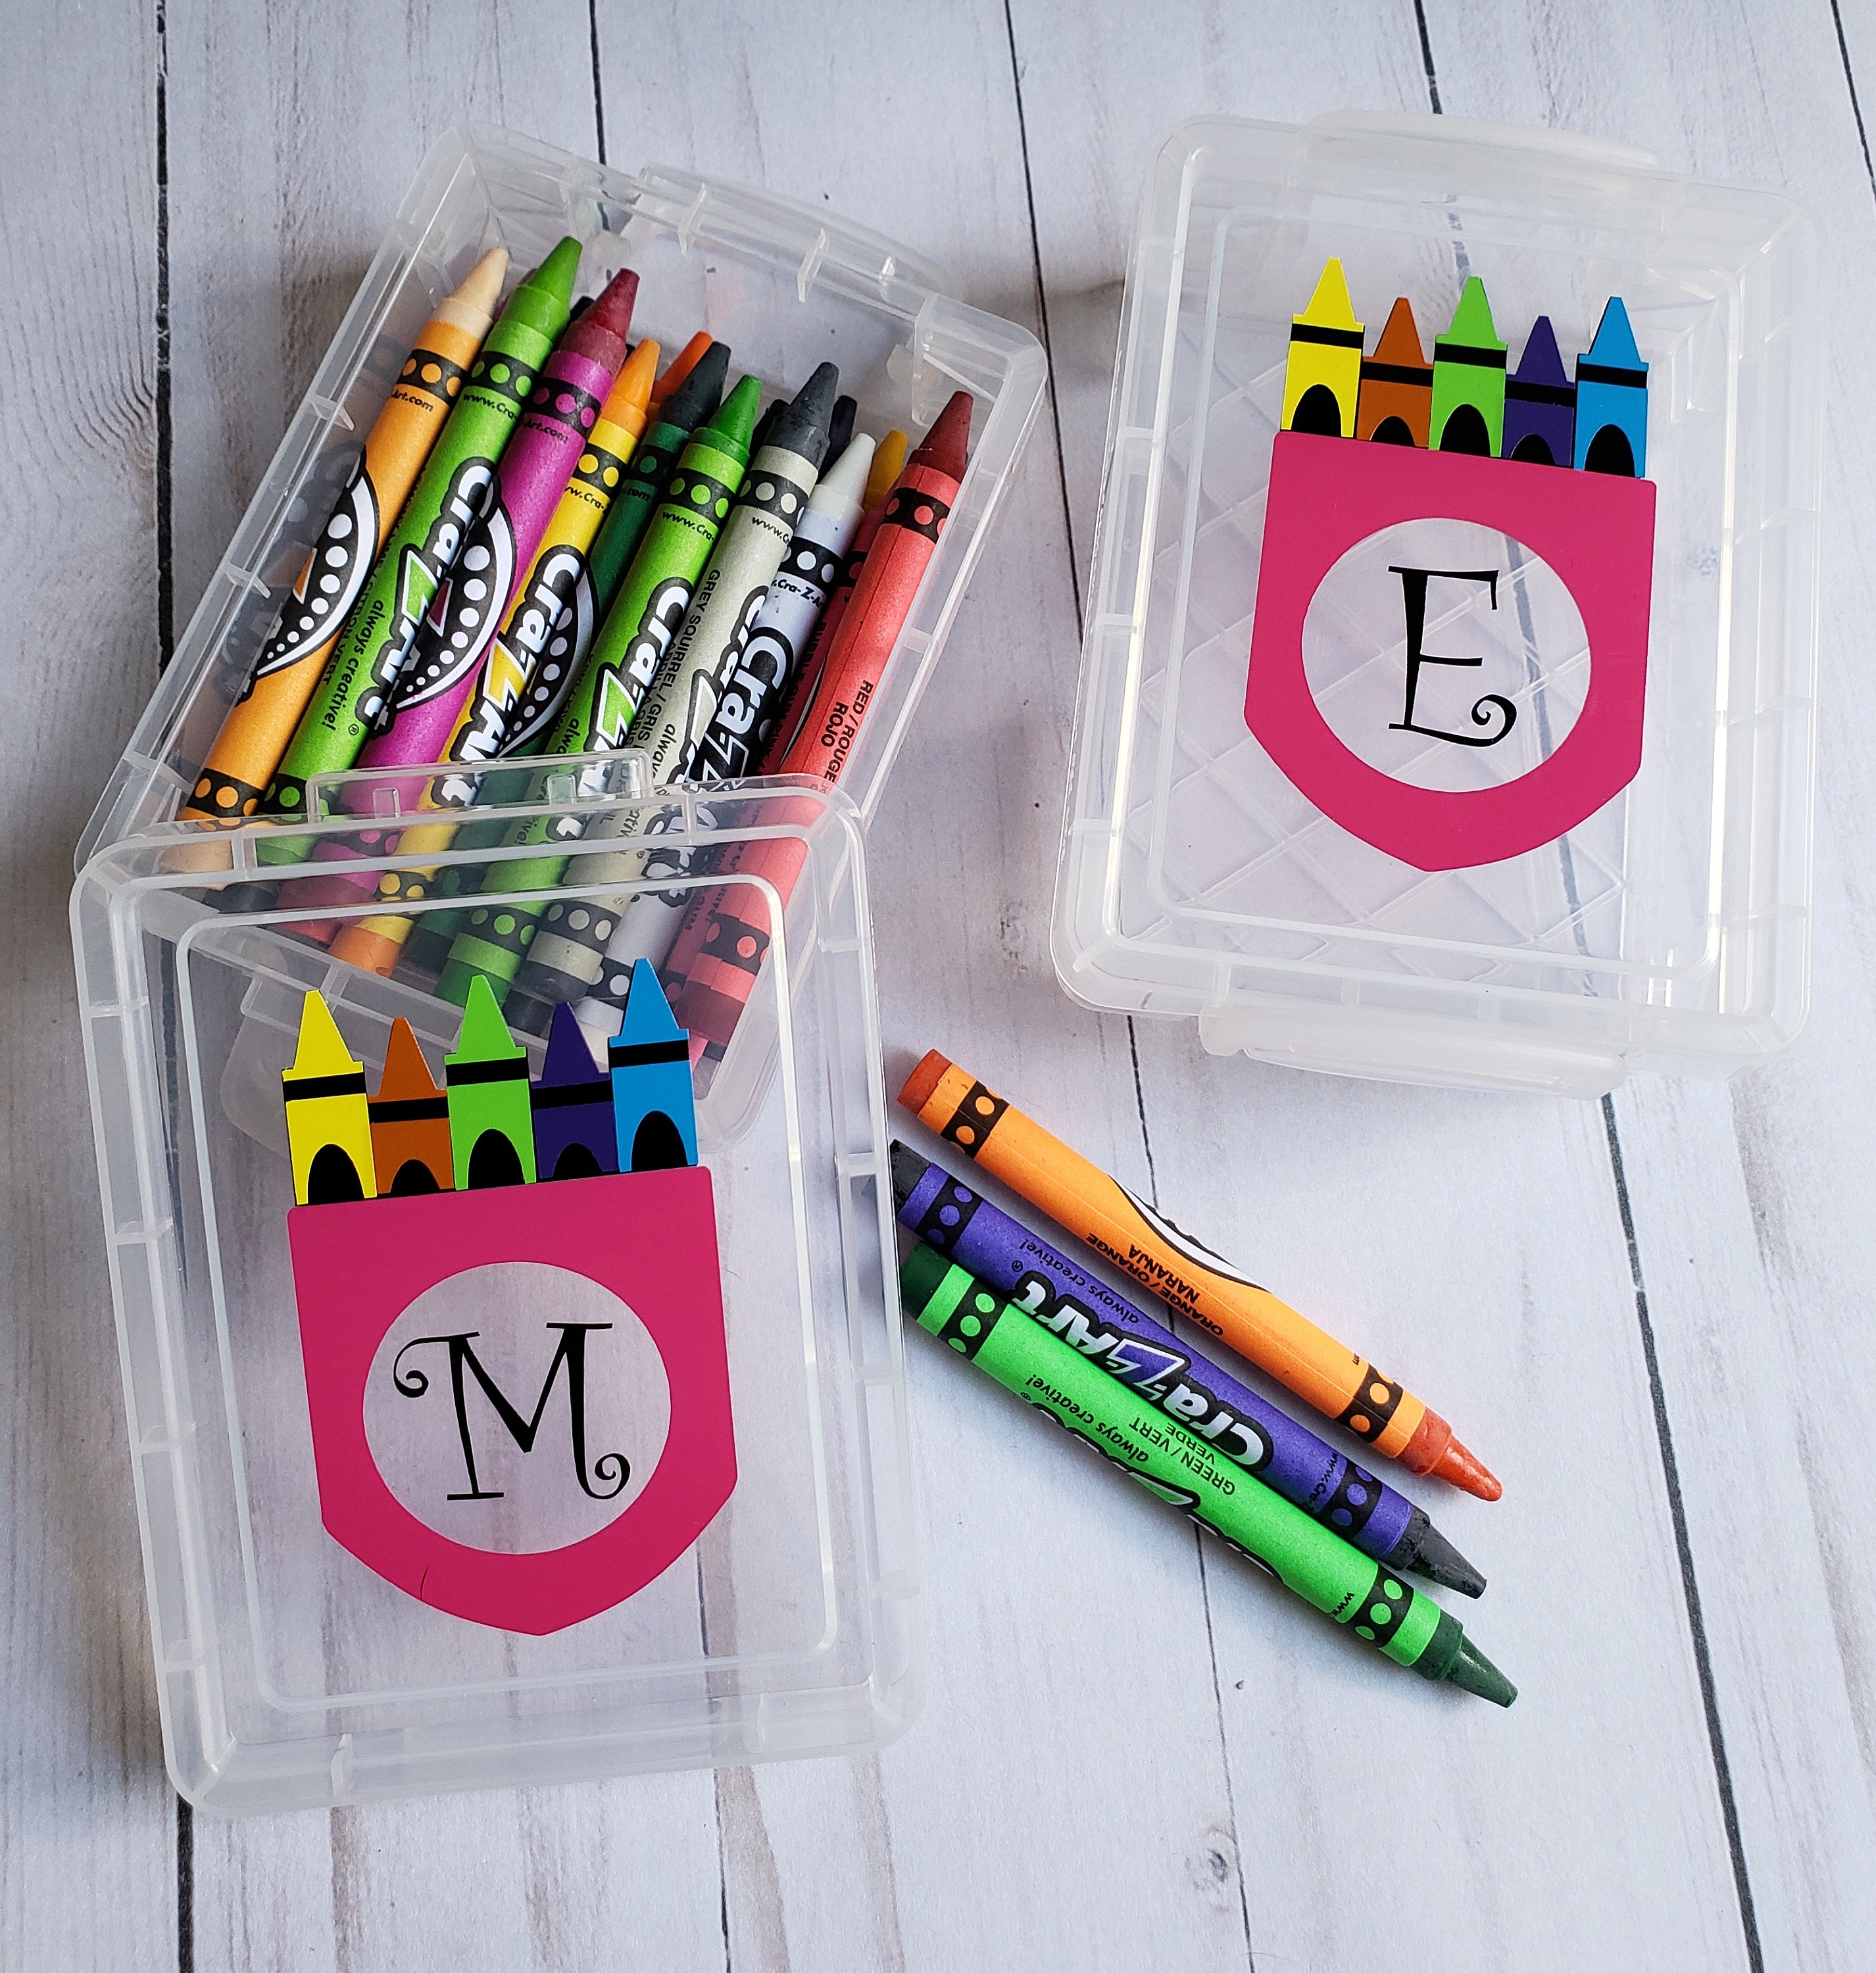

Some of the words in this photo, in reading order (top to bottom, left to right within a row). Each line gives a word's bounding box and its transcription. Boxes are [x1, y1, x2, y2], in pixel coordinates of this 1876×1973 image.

[696, 569, 720, 613] GREY
[354, 600, 385, 655] always
[662, 613, 701, 696] SQUIRREL
[1387, 565, 1517, 748] E
[322, 658, 359, 731] creative!
[852, 679, 874, 715] RED
[637, 706, 662, 742] GRIS
[821, 701, 849, 748] ROJO
[824, 726, 856, 783] ROUGE
[1020, 1238, 1086, 1286] creative!
[1085, 1232, 1150, 1282] ORANGE
[1128, 1244, 1200, 1304] NARANJA
[1088, 1285, 1139, 1324] always
[1158, 1286, 1223, 1336] ORANGE
[393, 1322, 631, 1501] M
[1025, 1374, 1094, 1425] creative!
[1095, 1422, 1149, 1463] always
[1128, 1417, 1170, 1452] VERT
[1165, 1422, 1215, 1465] VERDE
[1180, 1453, 1235, 1496] GREEN
